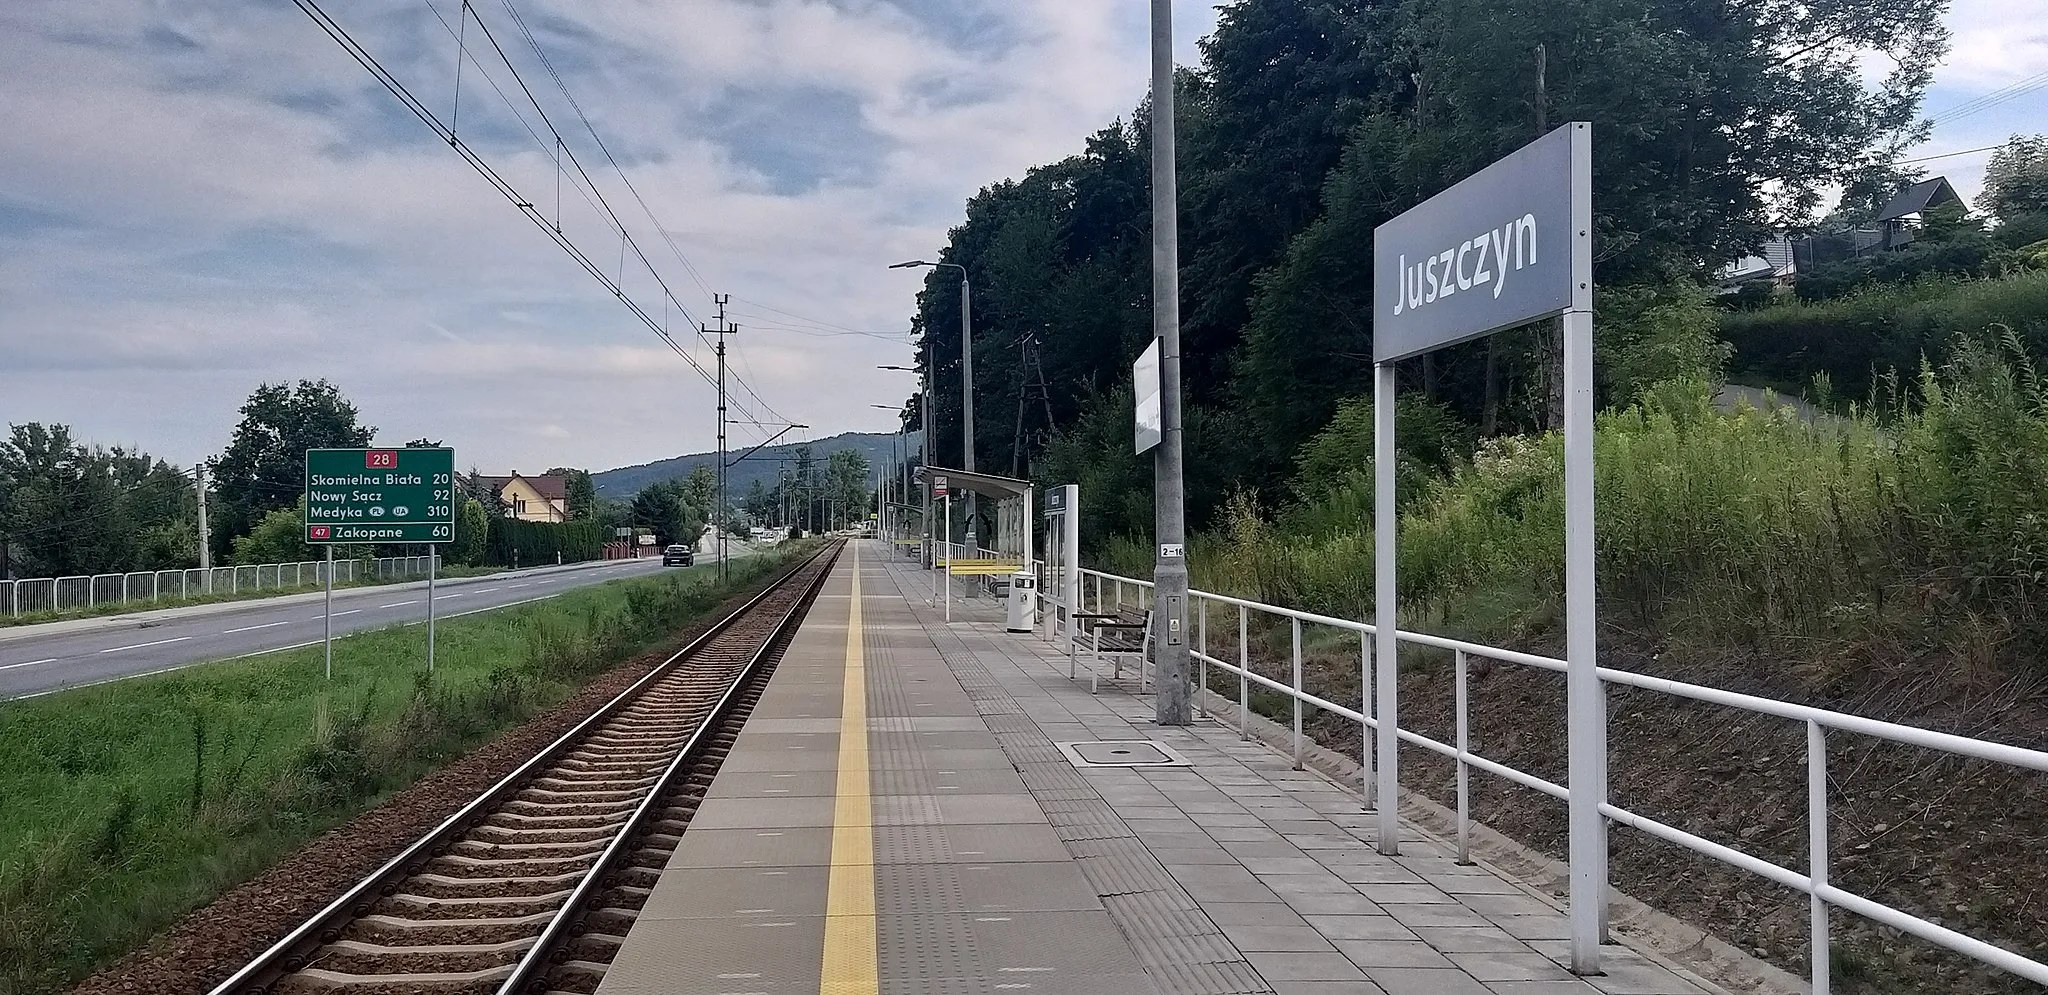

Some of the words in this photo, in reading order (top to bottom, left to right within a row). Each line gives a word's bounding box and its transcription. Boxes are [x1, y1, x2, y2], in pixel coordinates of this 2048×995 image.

[1393, 213, 1537, 316] Juszczyn
[373, 454, 390, 465] 28
[311, 474, 380, 486] Skomielna
[386, 473, 422, 485] Biała
[432, 473, 449, 485] 20
[311, 490, 347, 504] Nowy
[352, 490, 382, 504] Sącz
[433, 489, 450, 501] 92
[310, 506, 363, 520] Medyka
[427, 505, 449, 517] 310
[315, 528, 325, 537] 47
[335, 526, 403, 540] Zakopane
[432, 525, 449, 537] 60
